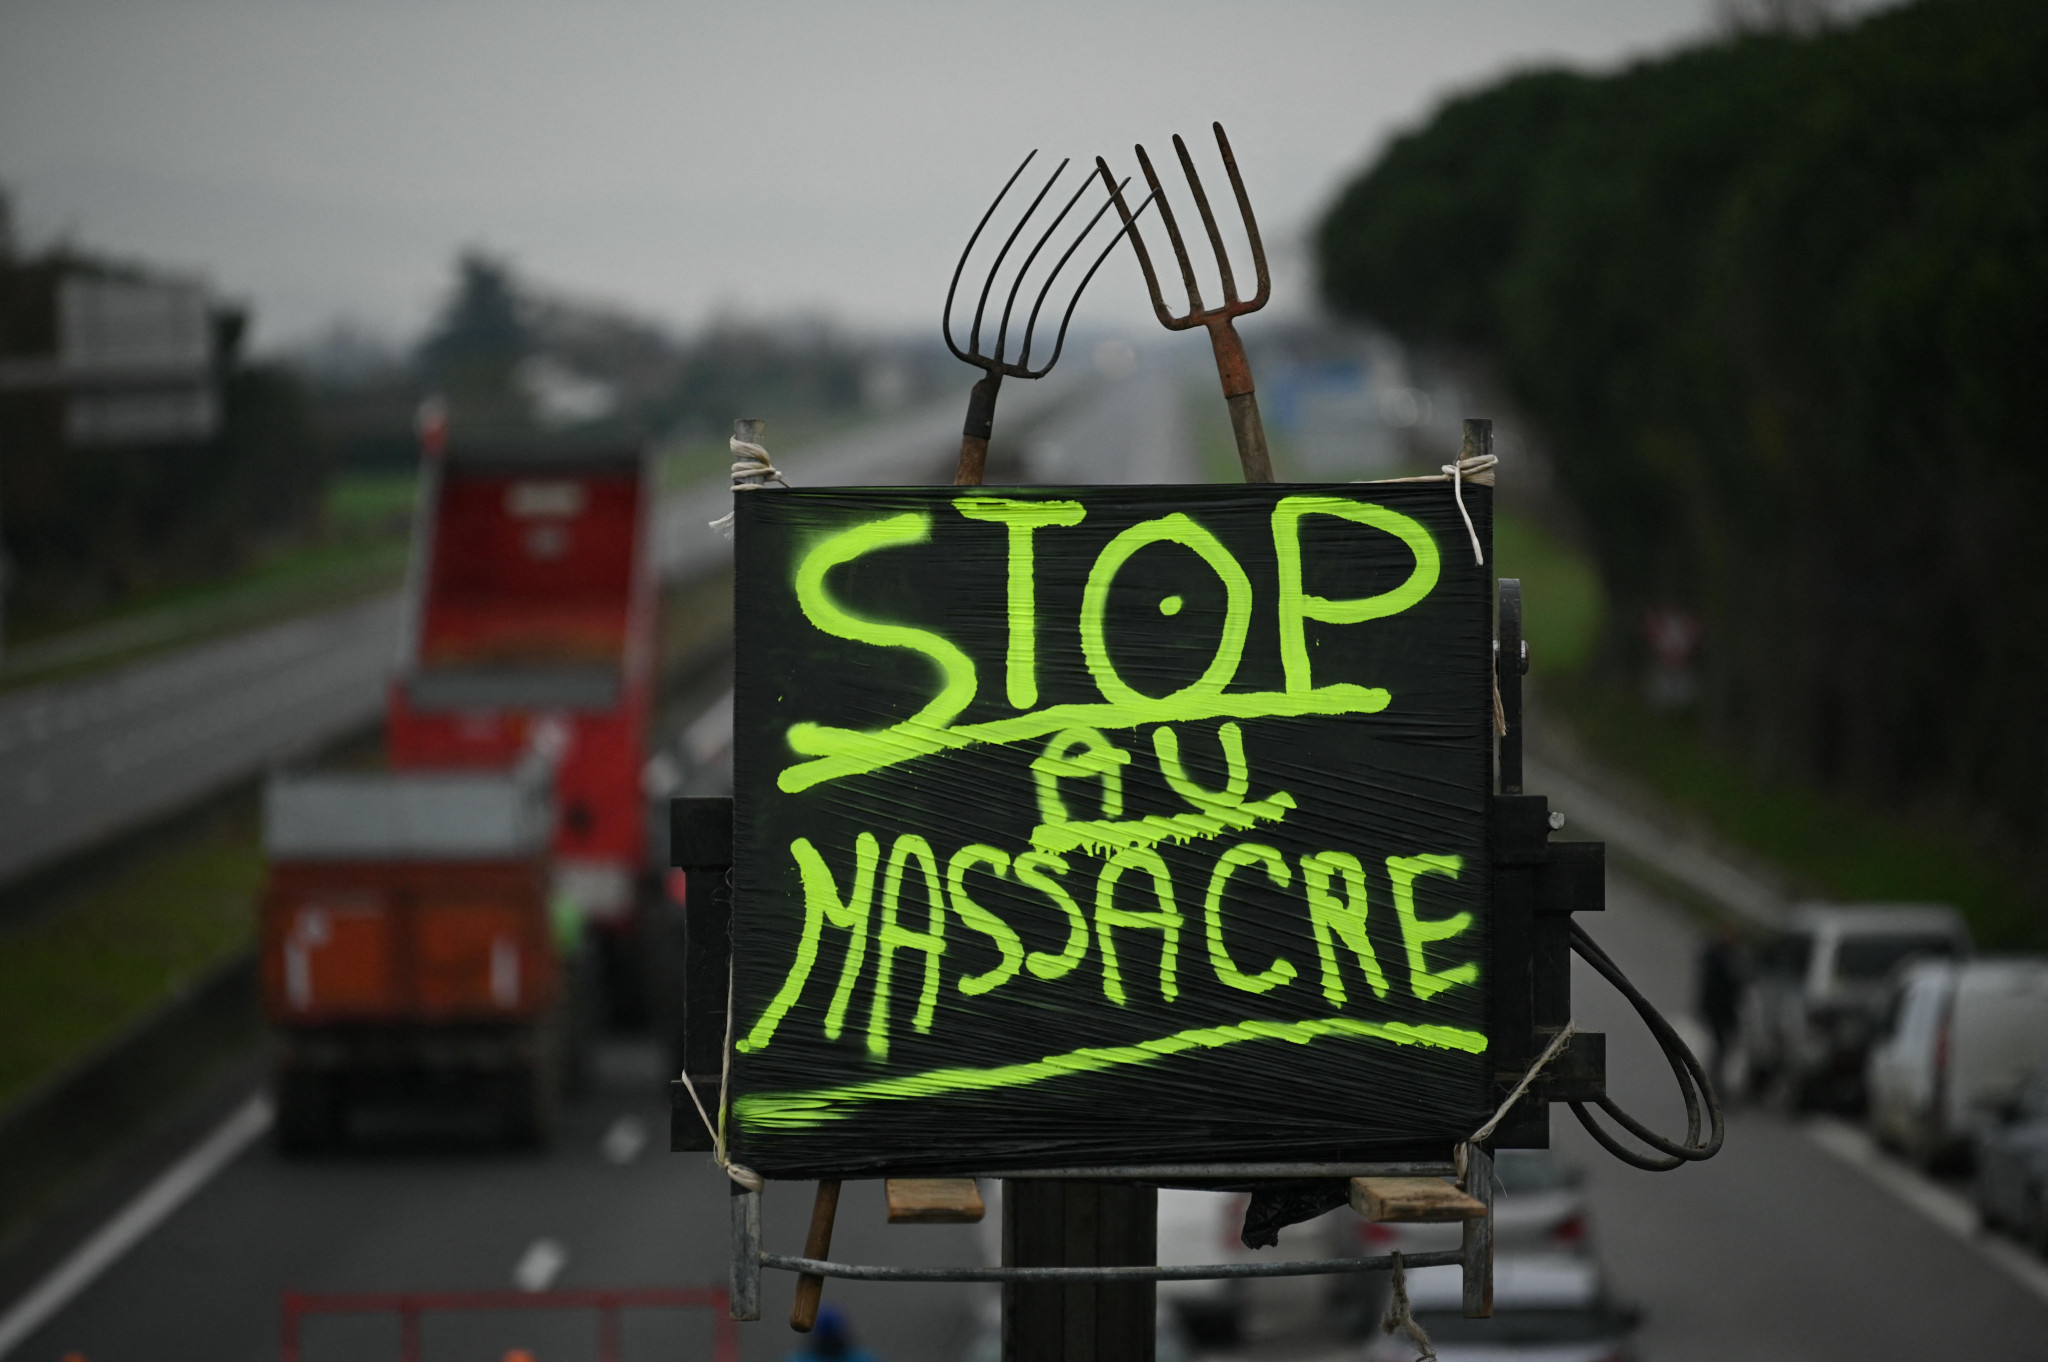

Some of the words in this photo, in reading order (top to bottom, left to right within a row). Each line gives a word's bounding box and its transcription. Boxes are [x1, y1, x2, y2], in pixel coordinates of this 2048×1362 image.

[786, 496, 1441, 757] STOP
[1030, 722, 1264, 828] AU
[736, 832, 1480, 1057] MASSACRE
